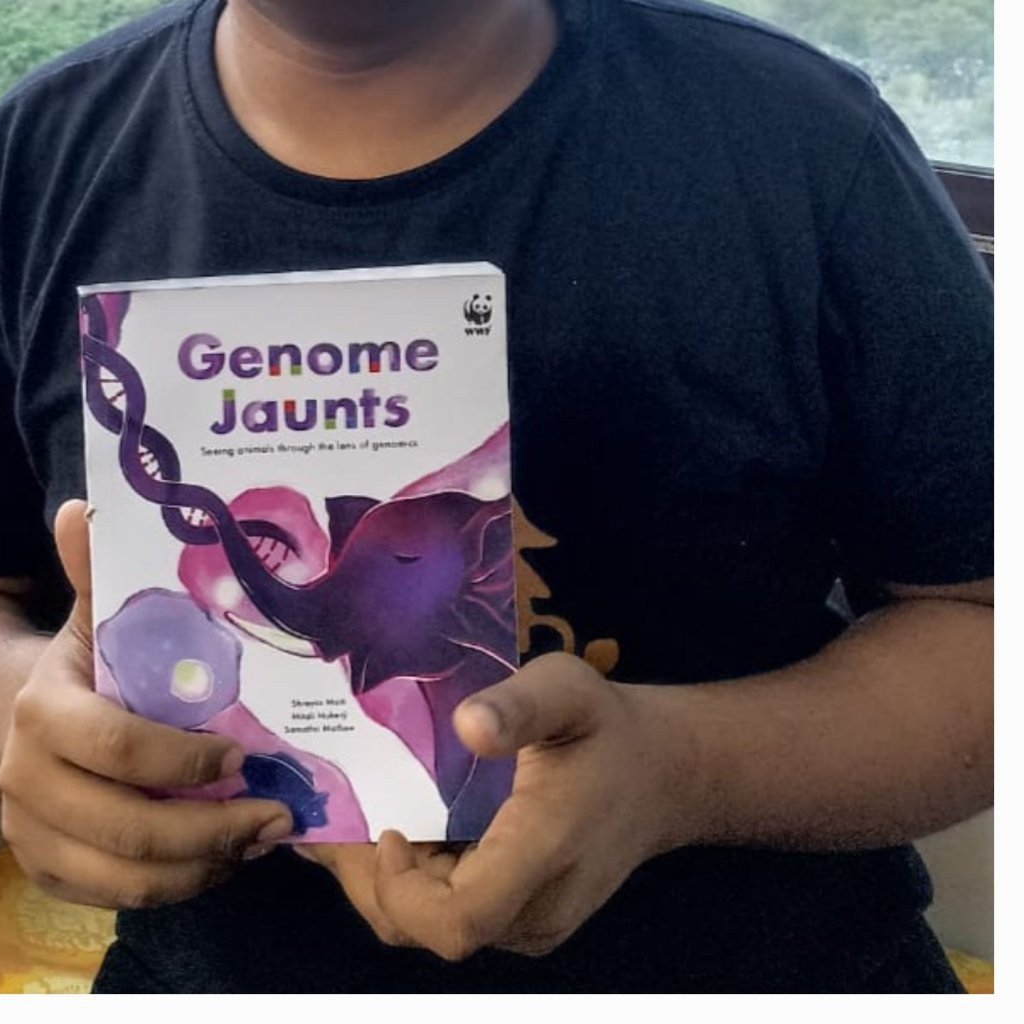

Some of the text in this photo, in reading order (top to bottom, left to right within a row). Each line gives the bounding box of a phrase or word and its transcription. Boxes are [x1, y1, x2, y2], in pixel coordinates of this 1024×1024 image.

[464, 326, 492, 336] WWF
[177, 333, 438, 381] Genome
[210, 389, 410, 435] Jaunts
[200, 440, 419, 457] Seeing animals through the lens of genomics
